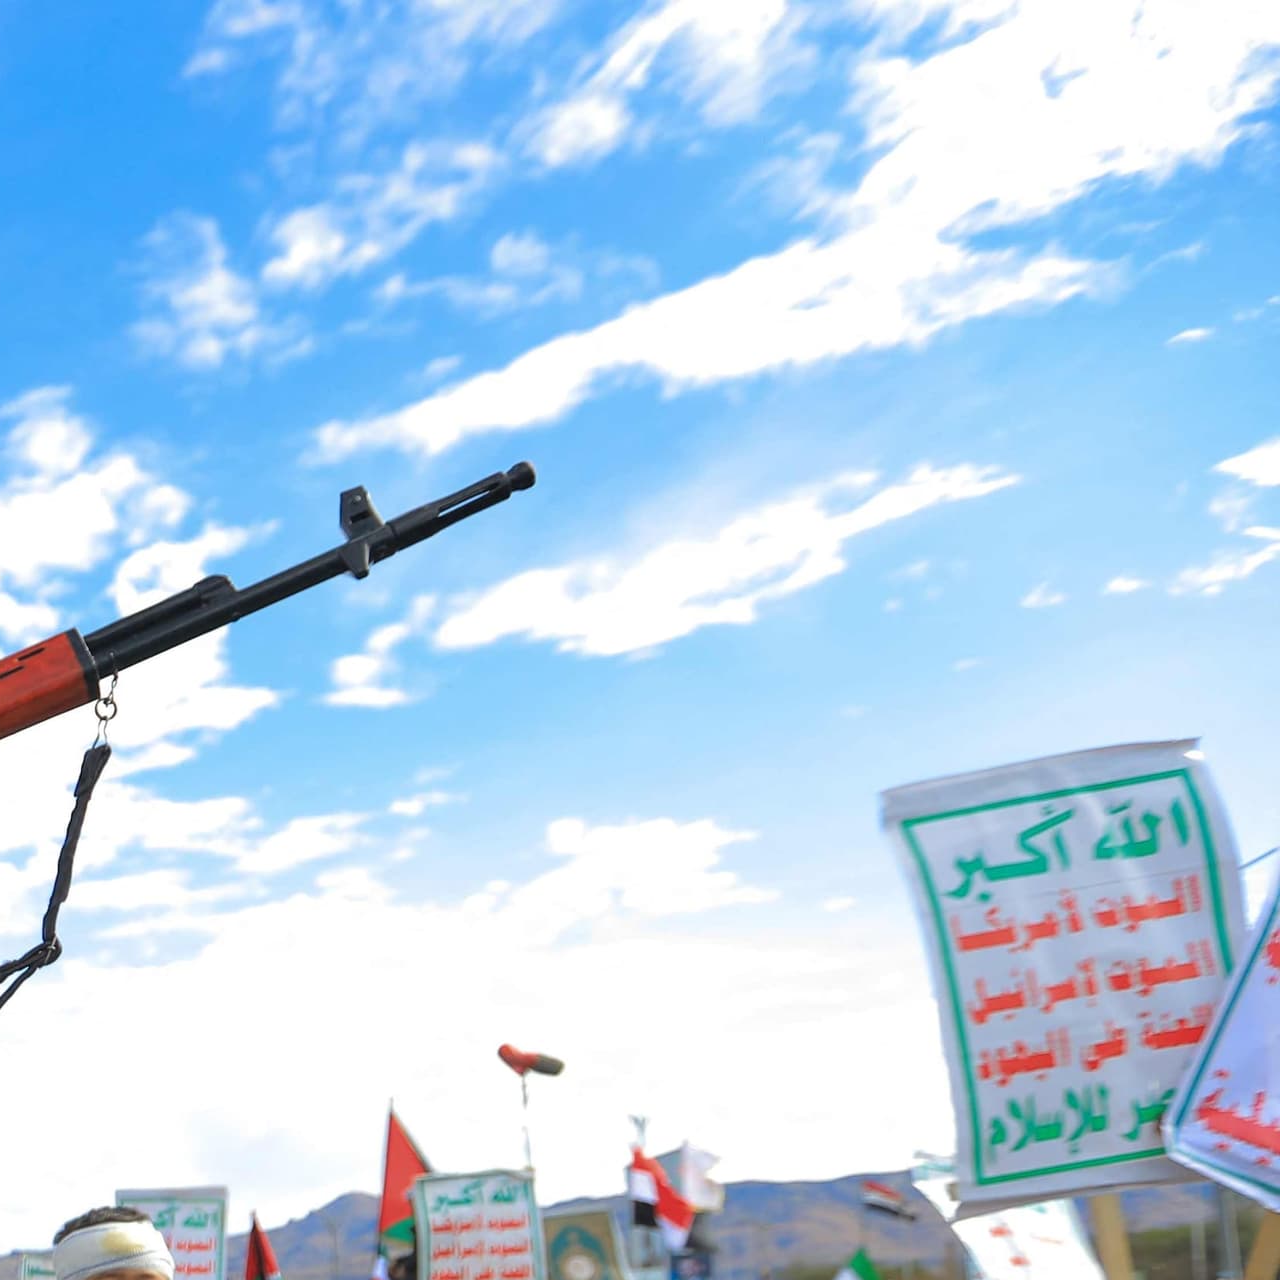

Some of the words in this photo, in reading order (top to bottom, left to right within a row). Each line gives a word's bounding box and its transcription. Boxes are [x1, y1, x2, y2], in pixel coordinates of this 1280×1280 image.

[943, 804, 1075, 902] أكبر
[1094, 797, 1189, 861] الله
[1095, 874, 1201, 932] الموت
[1108, 939, 1217, 997] الموت
